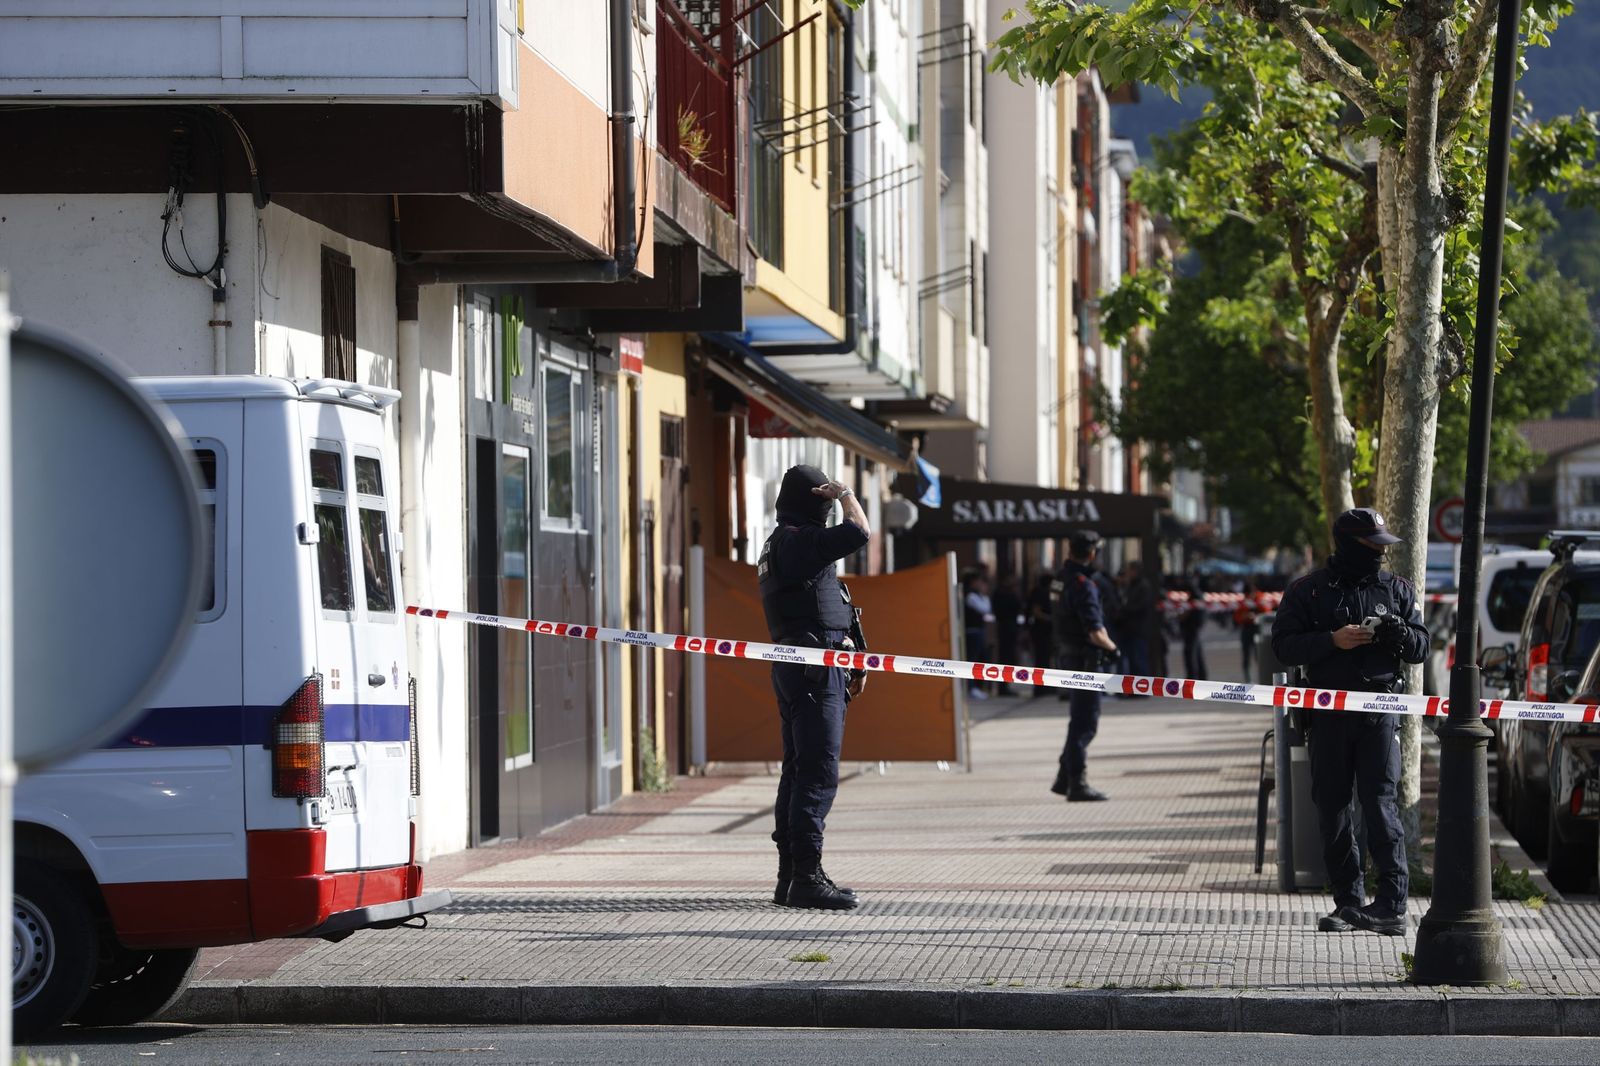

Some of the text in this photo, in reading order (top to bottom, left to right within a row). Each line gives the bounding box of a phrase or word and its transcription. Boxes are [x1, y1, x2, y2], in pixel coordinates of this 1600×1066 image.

[952, 499, 1100, 523] SARASUA
[625, 631, 648, 640] POLIZIA
[773, 646, 796, 654] POLIZIA
[921, 660, 945, 668] POLIZIA
[1071, 673, 1095, 681] POLIZIA
[1222, 684, 1246, 692] POLIZIA
[1375, 695, 1399, 703] POLIZIA
[1518, 711, 1565, 719] UDALTZAINGOA
